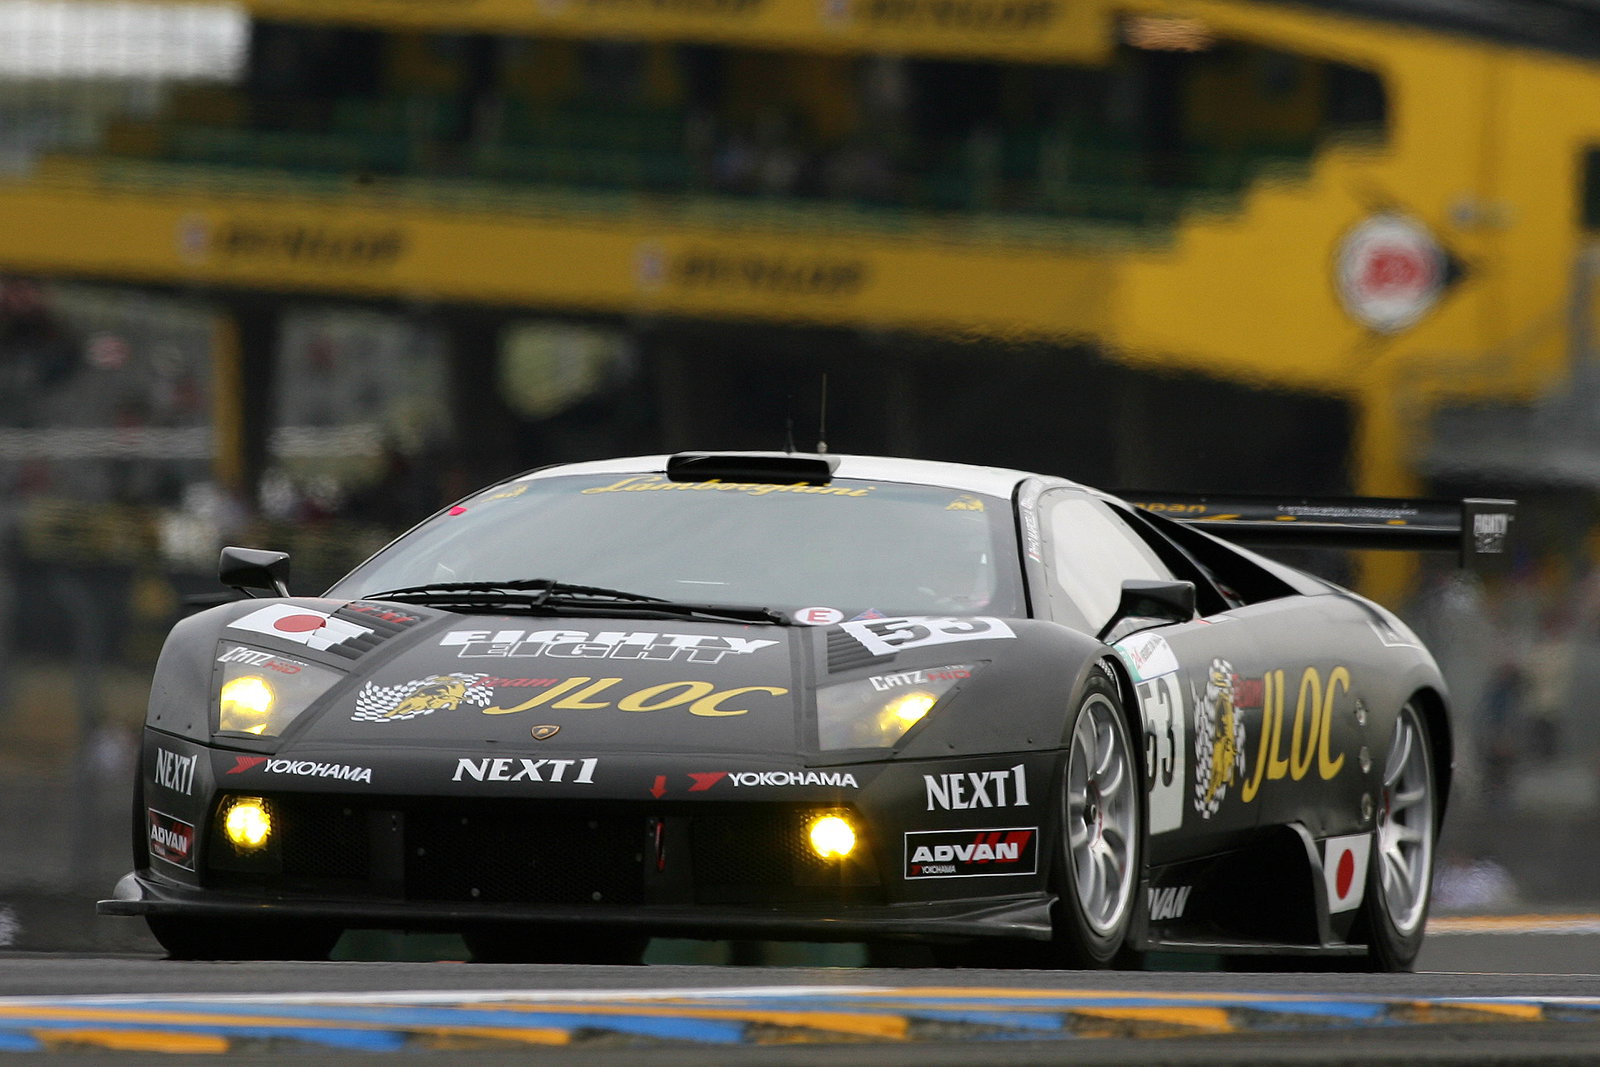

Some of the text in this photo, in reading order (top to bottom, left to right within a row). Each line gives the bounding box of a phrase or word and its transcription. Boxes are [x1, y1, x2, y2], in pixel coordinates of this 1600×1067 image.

[581, 476, 876, 497] Lamborghini
[807, 610, 831, 622] E
[440, 630, 780, 655] EIGHTY
[217, 646, 276, 666] CATZ
[868, 670, 928, 691] CATZ
[482, 677, 788, 717] JLOC
[1242, 666, 1350, 803] JLOC
[155, 748, 198, 796] NEXT1
[264, 758, 373, 784] YOKOHAMA
[452, 758, 597, 784] NEXT1
[728, 772, 858, 789] YOKOHAMA
[923, 764, 1030, 811] NEXT1
[151, 824, 188, 853] ADVAN
[911, 842, 1020, 863] ADVAN
[921, 865, 957, 874] YOKOHAMA
